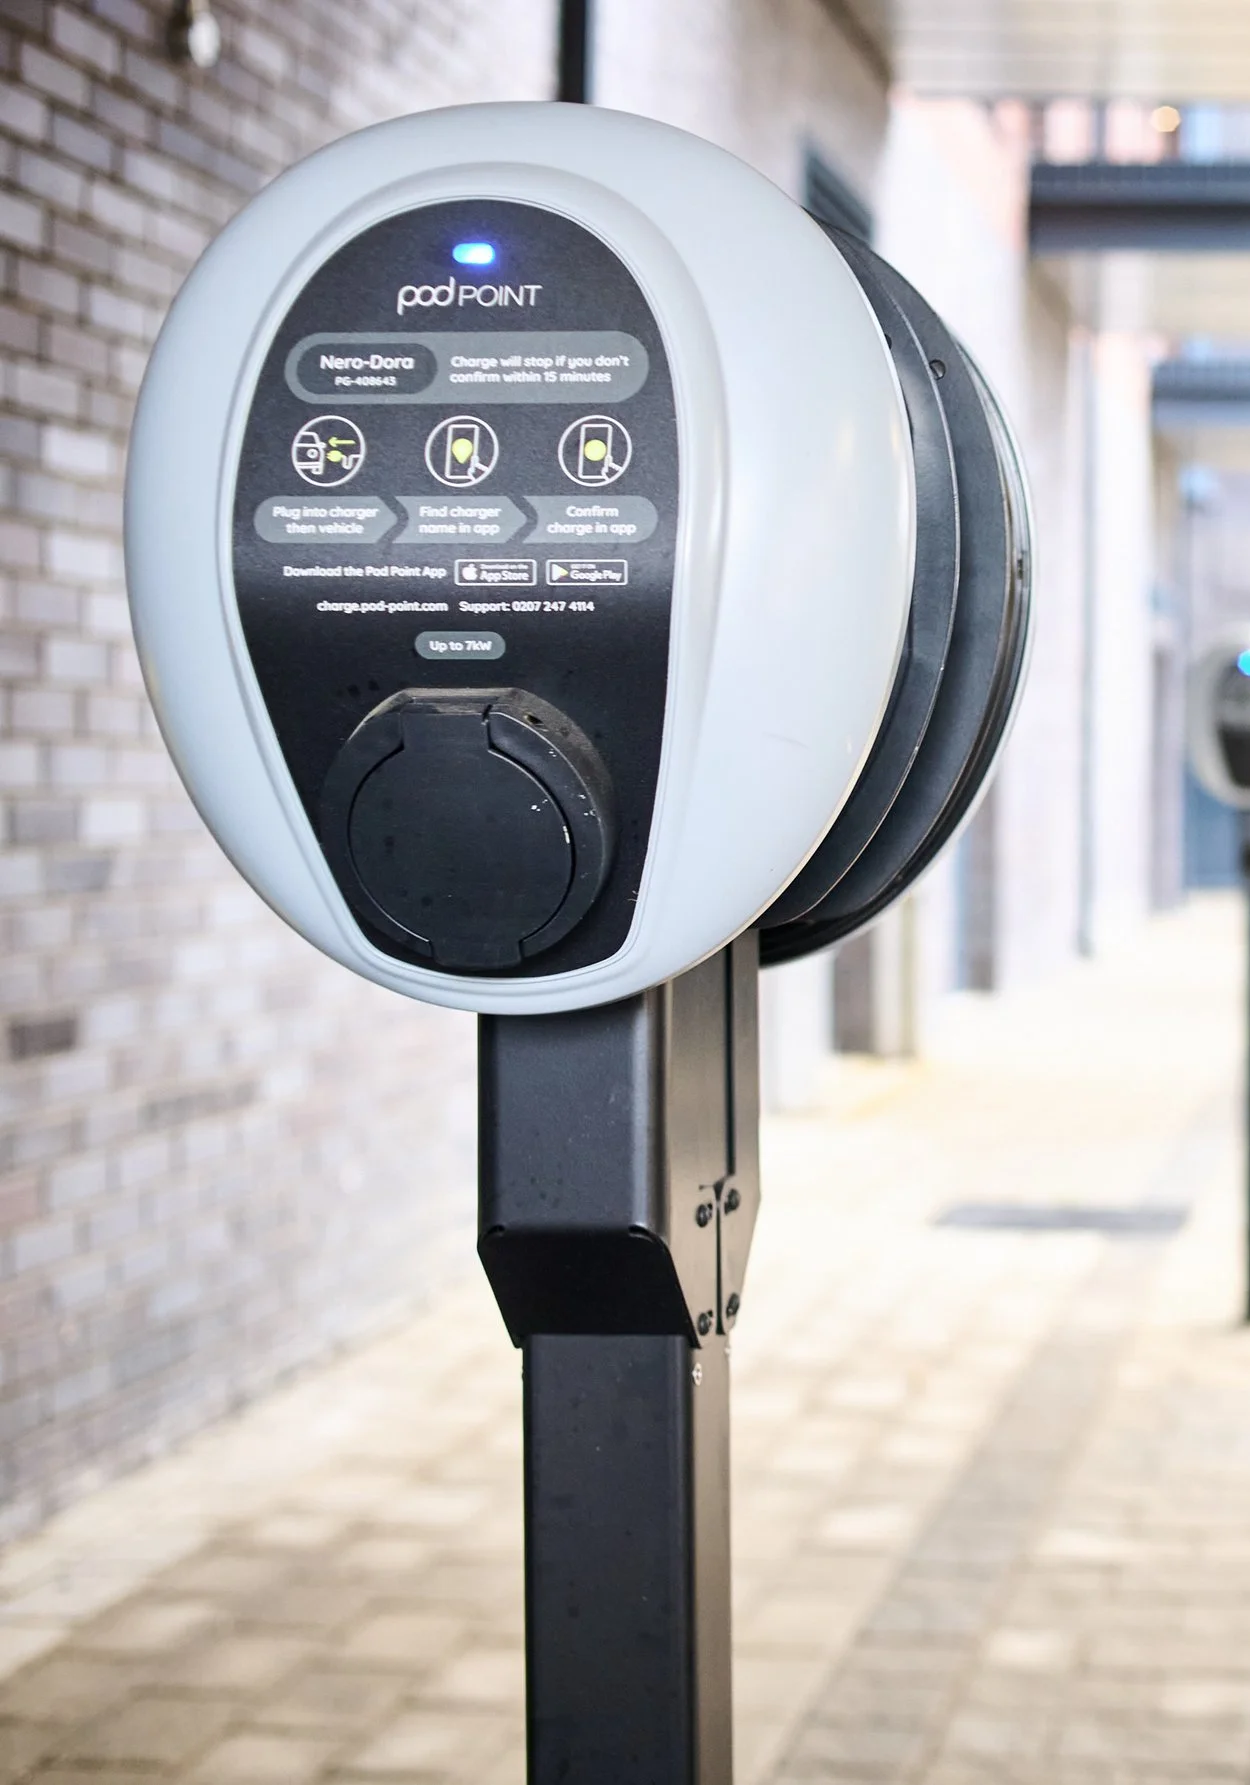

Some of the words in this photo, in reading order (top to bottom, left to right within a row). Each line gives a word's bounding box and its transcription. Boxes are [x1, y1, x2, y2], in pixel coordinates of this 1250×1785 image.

[397, 276, 455, 315] pod
[458, 285, 542, 307] POINT
[320, 354, 414, 370] Nero-Dora
[450, 356, 498, 370] Charge
[500, 355, 522, 367] will
[523, 357, 554, 369] stop
[555, 355, 566, 367] if
[567, 357, 593, 369] you
[594, 355, 630, 367] don't
[450, 371, 501, 383] confirm
[502, 371, 542, 382] within
[543, 371, 558, 382] 15
[559, 371, 612, 382] minutes
[272, 506, 301, 520] Plug
[302, 506, 328, 518] into
[329, 506, 379, 520] charger
[419, 506, 448, 517] Find
[449, 506, 502, 520] charger
[566, 505, 619, 517] Confirm
[286, 522, 316, 534] then
[318, 522, 364, 534] vehicle
[418, 524, 457, 534] name
[458, 522, 471, 533] in
[473, 524, 500, 536] app
[546, 522, 593, 536] charge
[595, 522, 608, 533] in
[609, 524, 637, 536] app
[283, 566, 341, 577] Download
[342, 566, 364, 577] the
[365, 566, 389, 577] Pod
[391, 566, 421, 577] Point
[422, 566, 447, 579] App
[479, 570, 503, 582] App
[502, 570, 529, 581] Store
[570, 570, 602, 582] Google
[601, 570, 622, 581] Play
[316, 600, 449, 614] charge.pod-point.com
[458, 601, 511, 614] Support:
[512, 601, 542, 612] 0207
[543, 601, 566, 612] 247
[568, 601, 595, 611] 4114
[429, 641, 447, 653] Up
[448, 641, 463, 651] to
[465, 640, 492, 651] 7kW
